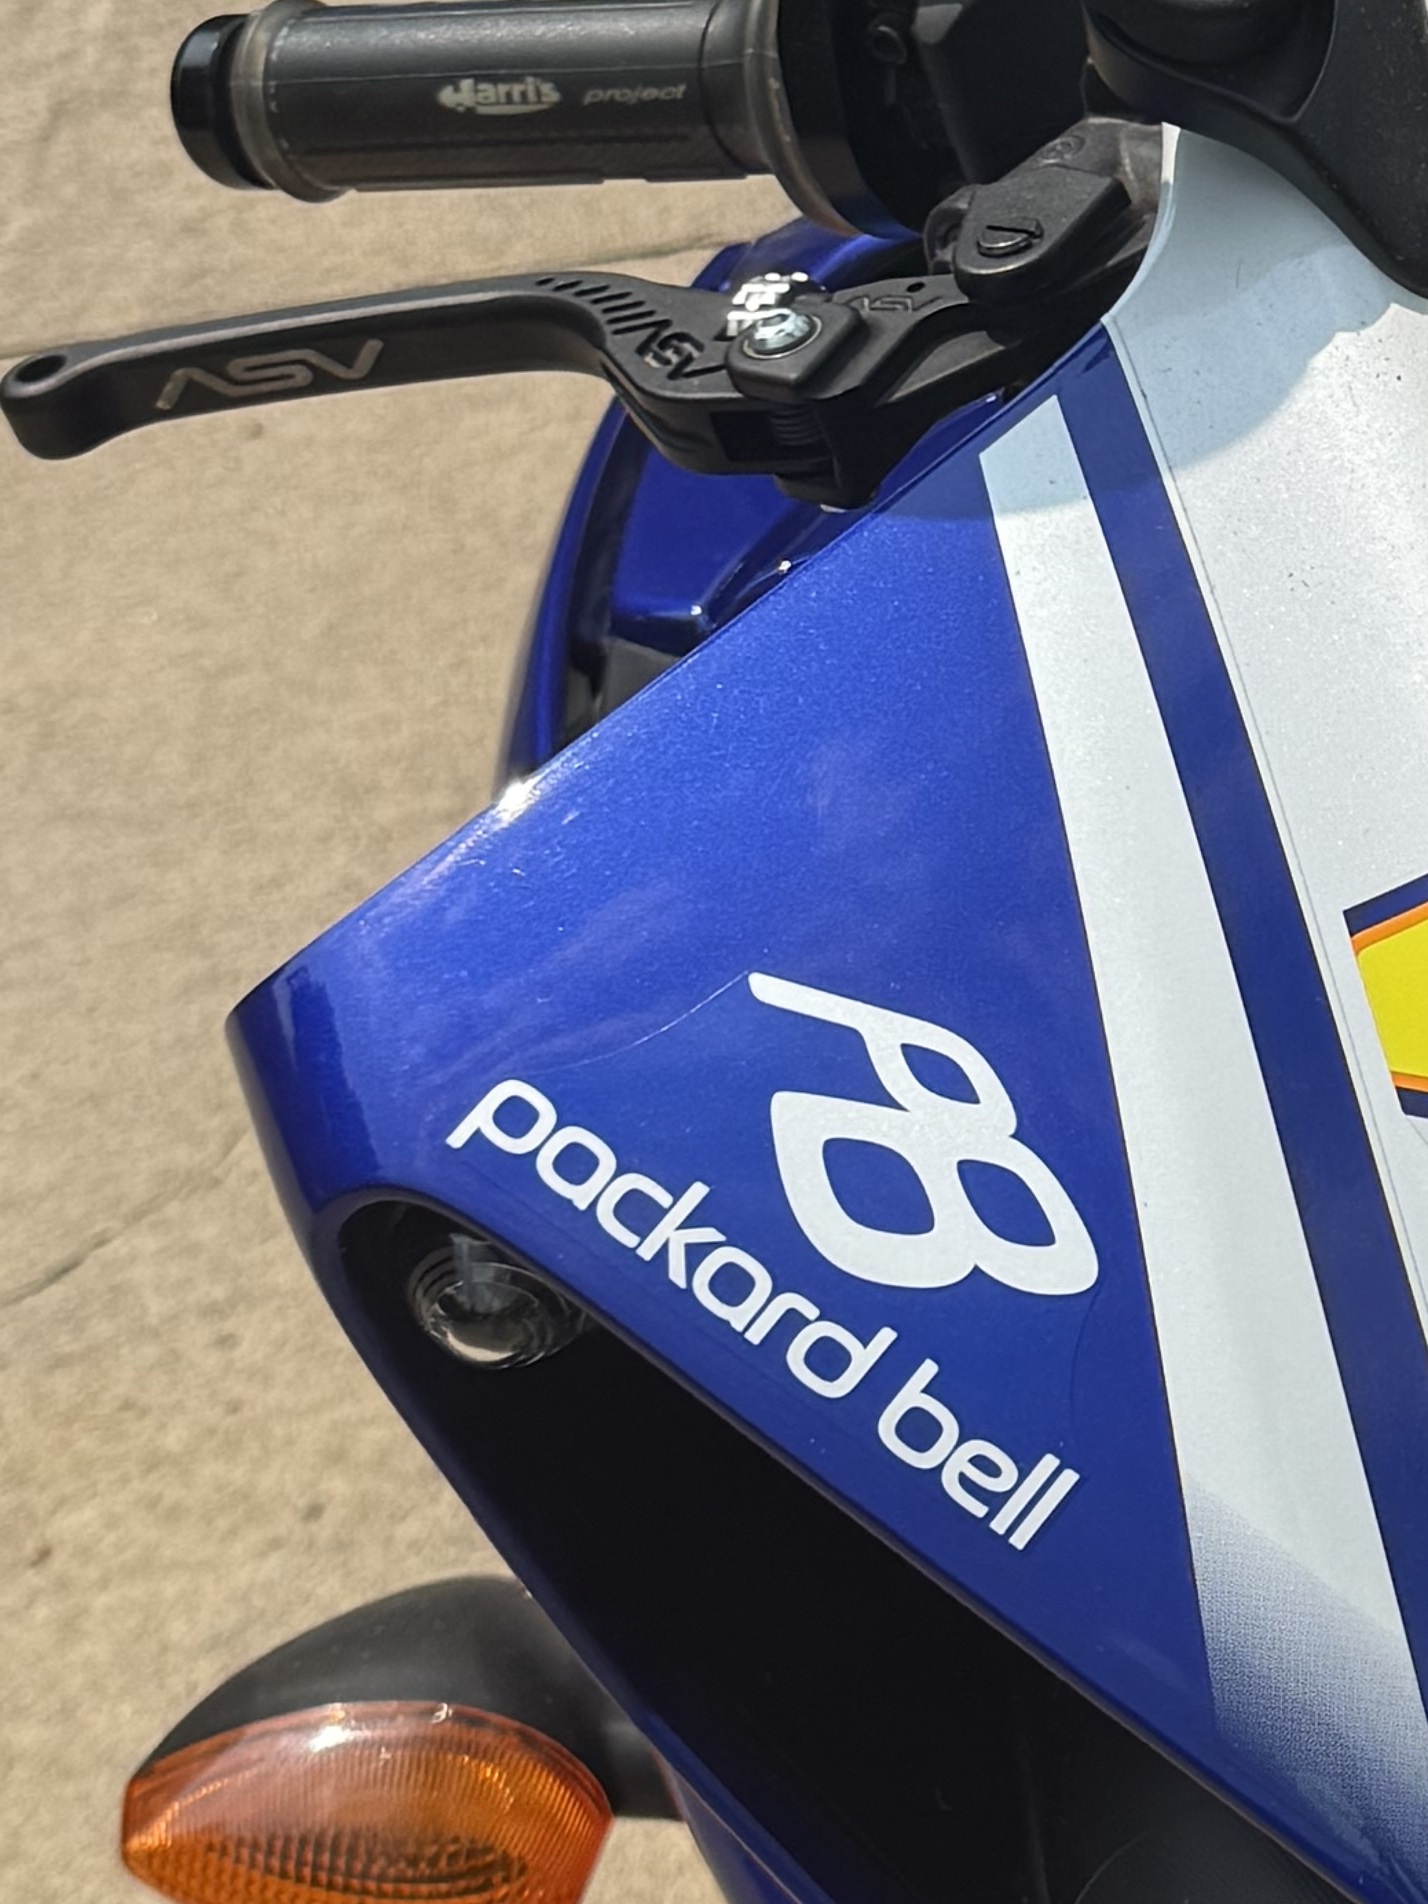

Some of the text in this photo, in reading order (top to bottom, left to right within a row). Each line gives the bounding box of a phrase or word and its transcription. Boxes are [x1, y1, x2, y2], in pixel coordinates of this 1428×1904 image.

[582, 83, 686, 107] project
[154, 337, 385, 412] ASV
[447, 1078, 1082, 1553] packard bell
